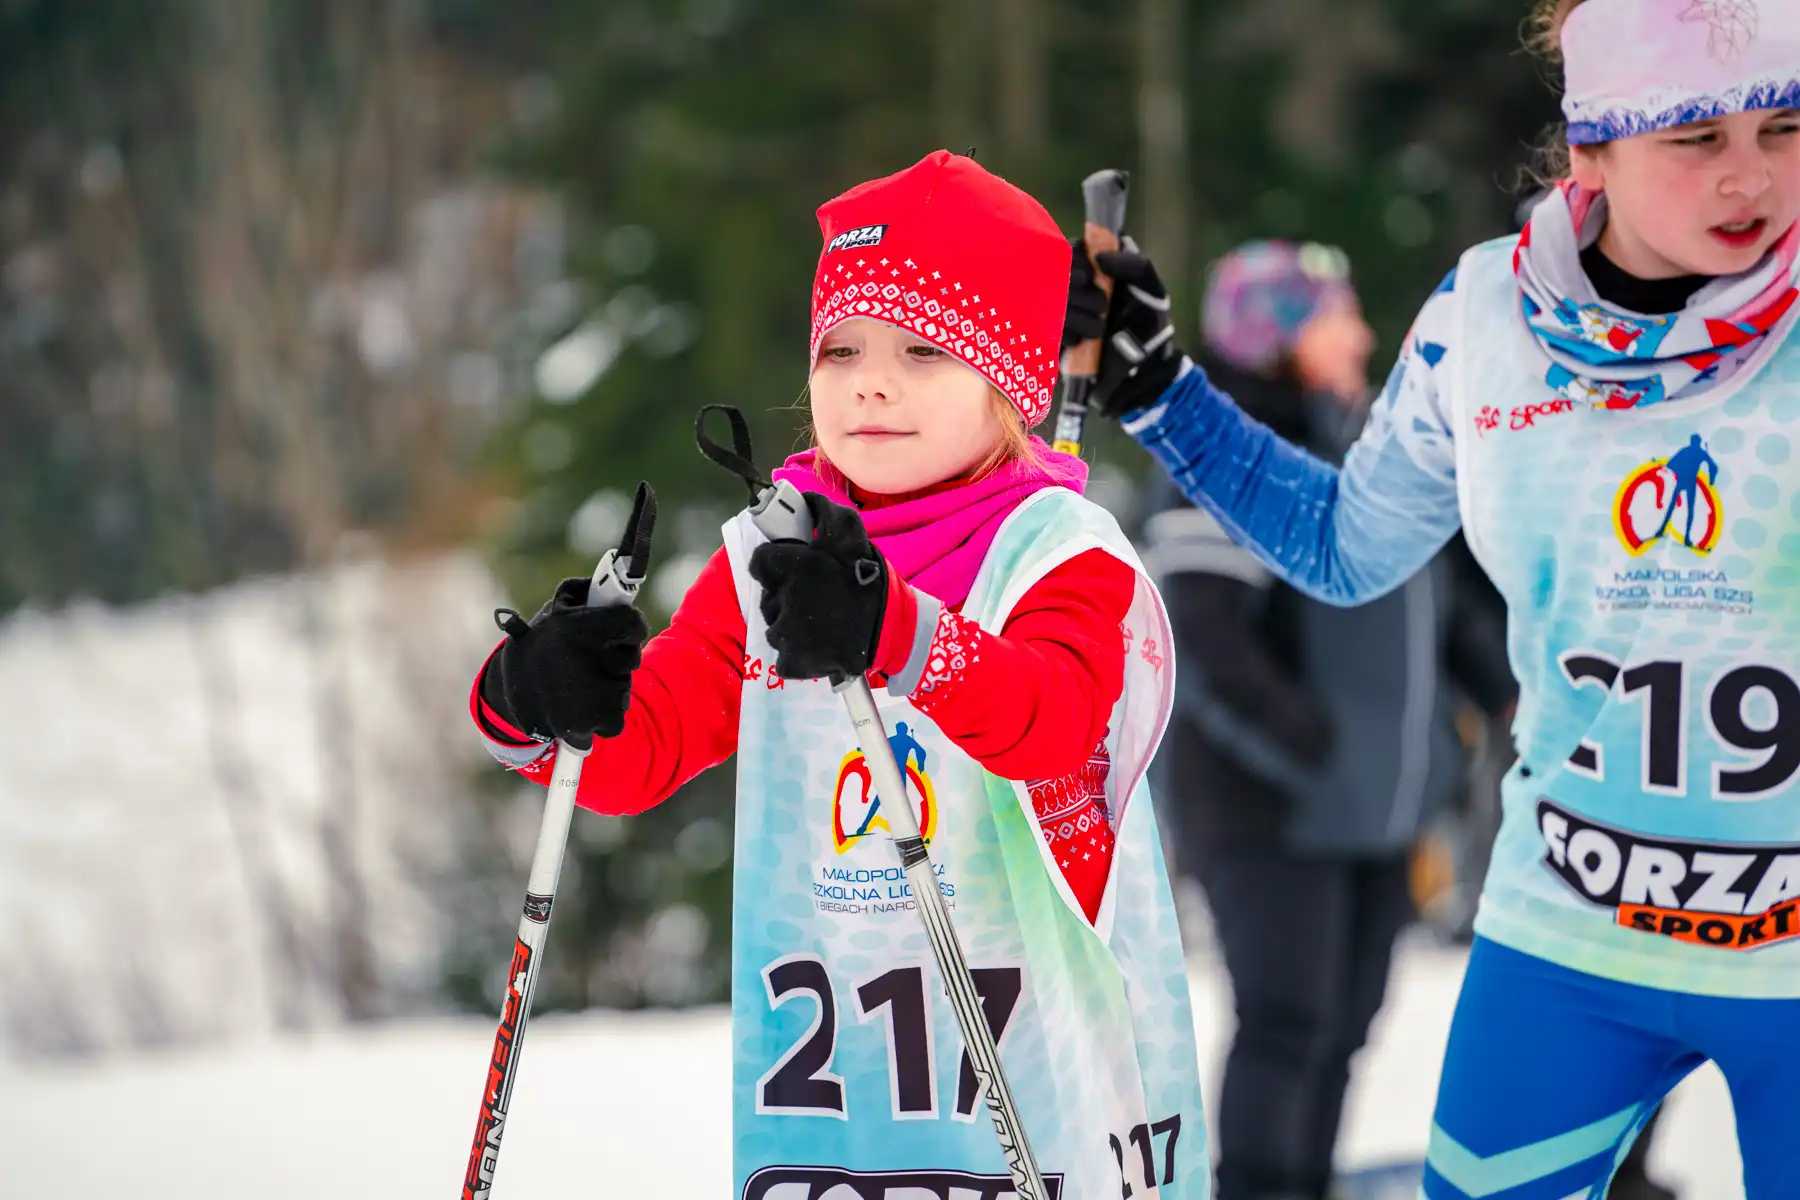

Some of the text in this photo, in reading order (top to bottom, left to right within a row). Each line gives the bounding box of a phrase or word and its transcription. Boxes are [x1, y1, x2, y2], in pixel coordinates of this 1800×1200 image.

[826, 225, 884, 253] FORZA
[845, 239, 880, 248] SPORT
[1542, 811, 1800, 916] FORZA
[819, 901, 869, 914] BIEGACH
[1631, 904, 1796, 946] SPORT
[759, 956, 1024, 1120] 217
